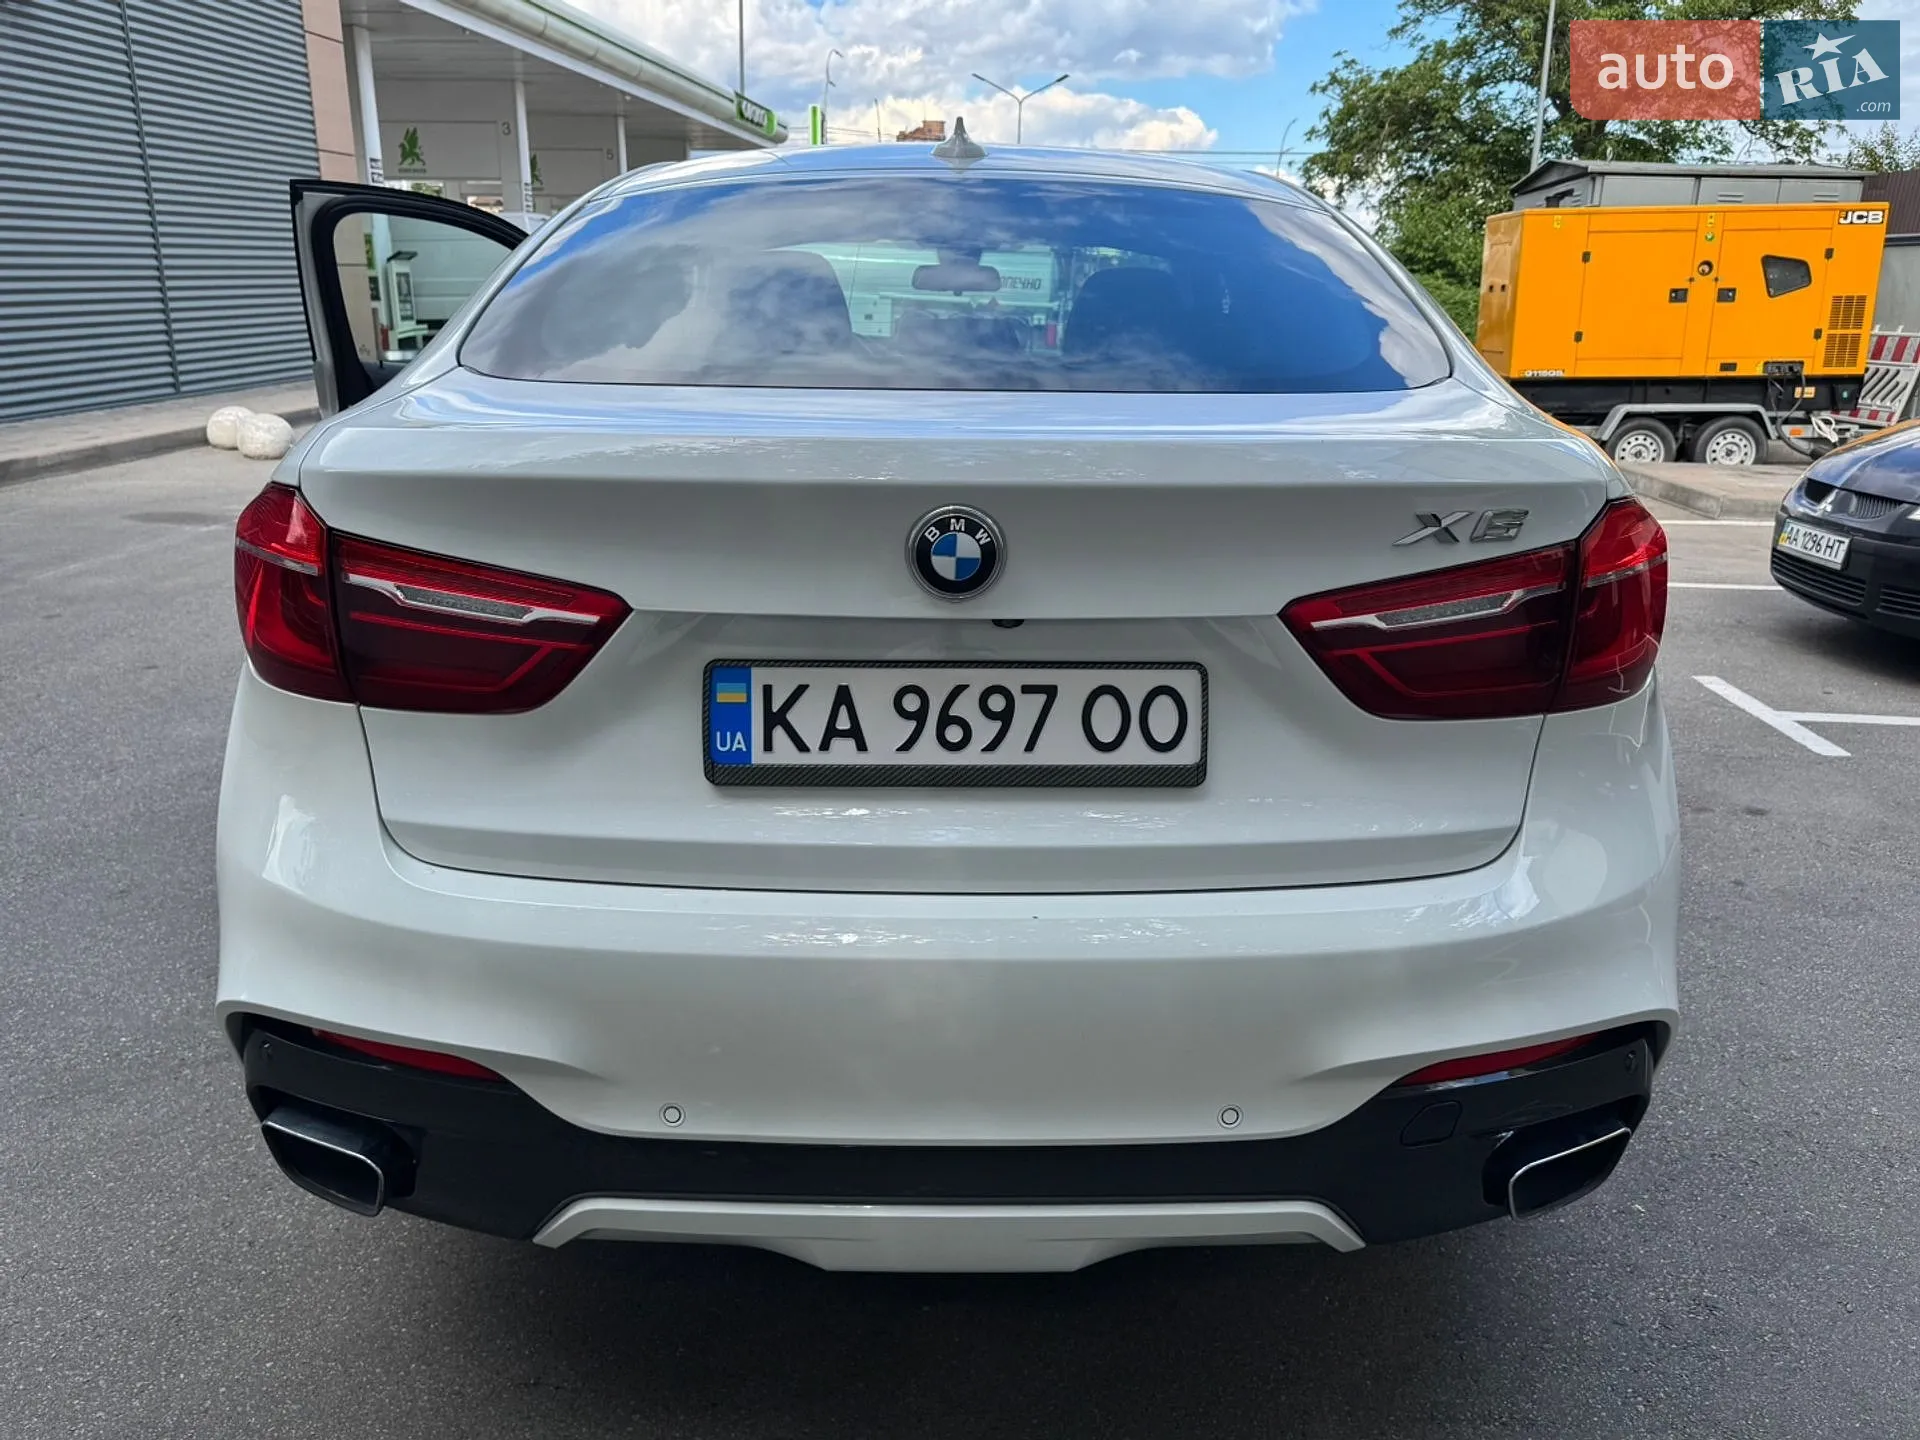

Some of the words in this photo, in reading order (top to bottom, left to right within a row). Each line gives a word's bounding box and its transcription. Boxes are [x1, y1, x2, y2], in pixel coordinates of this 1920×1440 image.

[502, 121, 512, 136] 3
[606, 149, 614, 161] 5
[1839, 210, 1884, 225] JCB
[923, 517, 992, 546] BMW
[1392, 508, 1530, 547] X6
[1786, 526, 1801, 546] AA
[1800, 531, 1825, 553] 1296
[1823, 536, 1846, 559] HT
[762, 683, 869, 753] KA
[893, 683, 1059, 753] 9697
[1081, 683, 1188, 753] OO
[716, 730, 747, 752] UA
